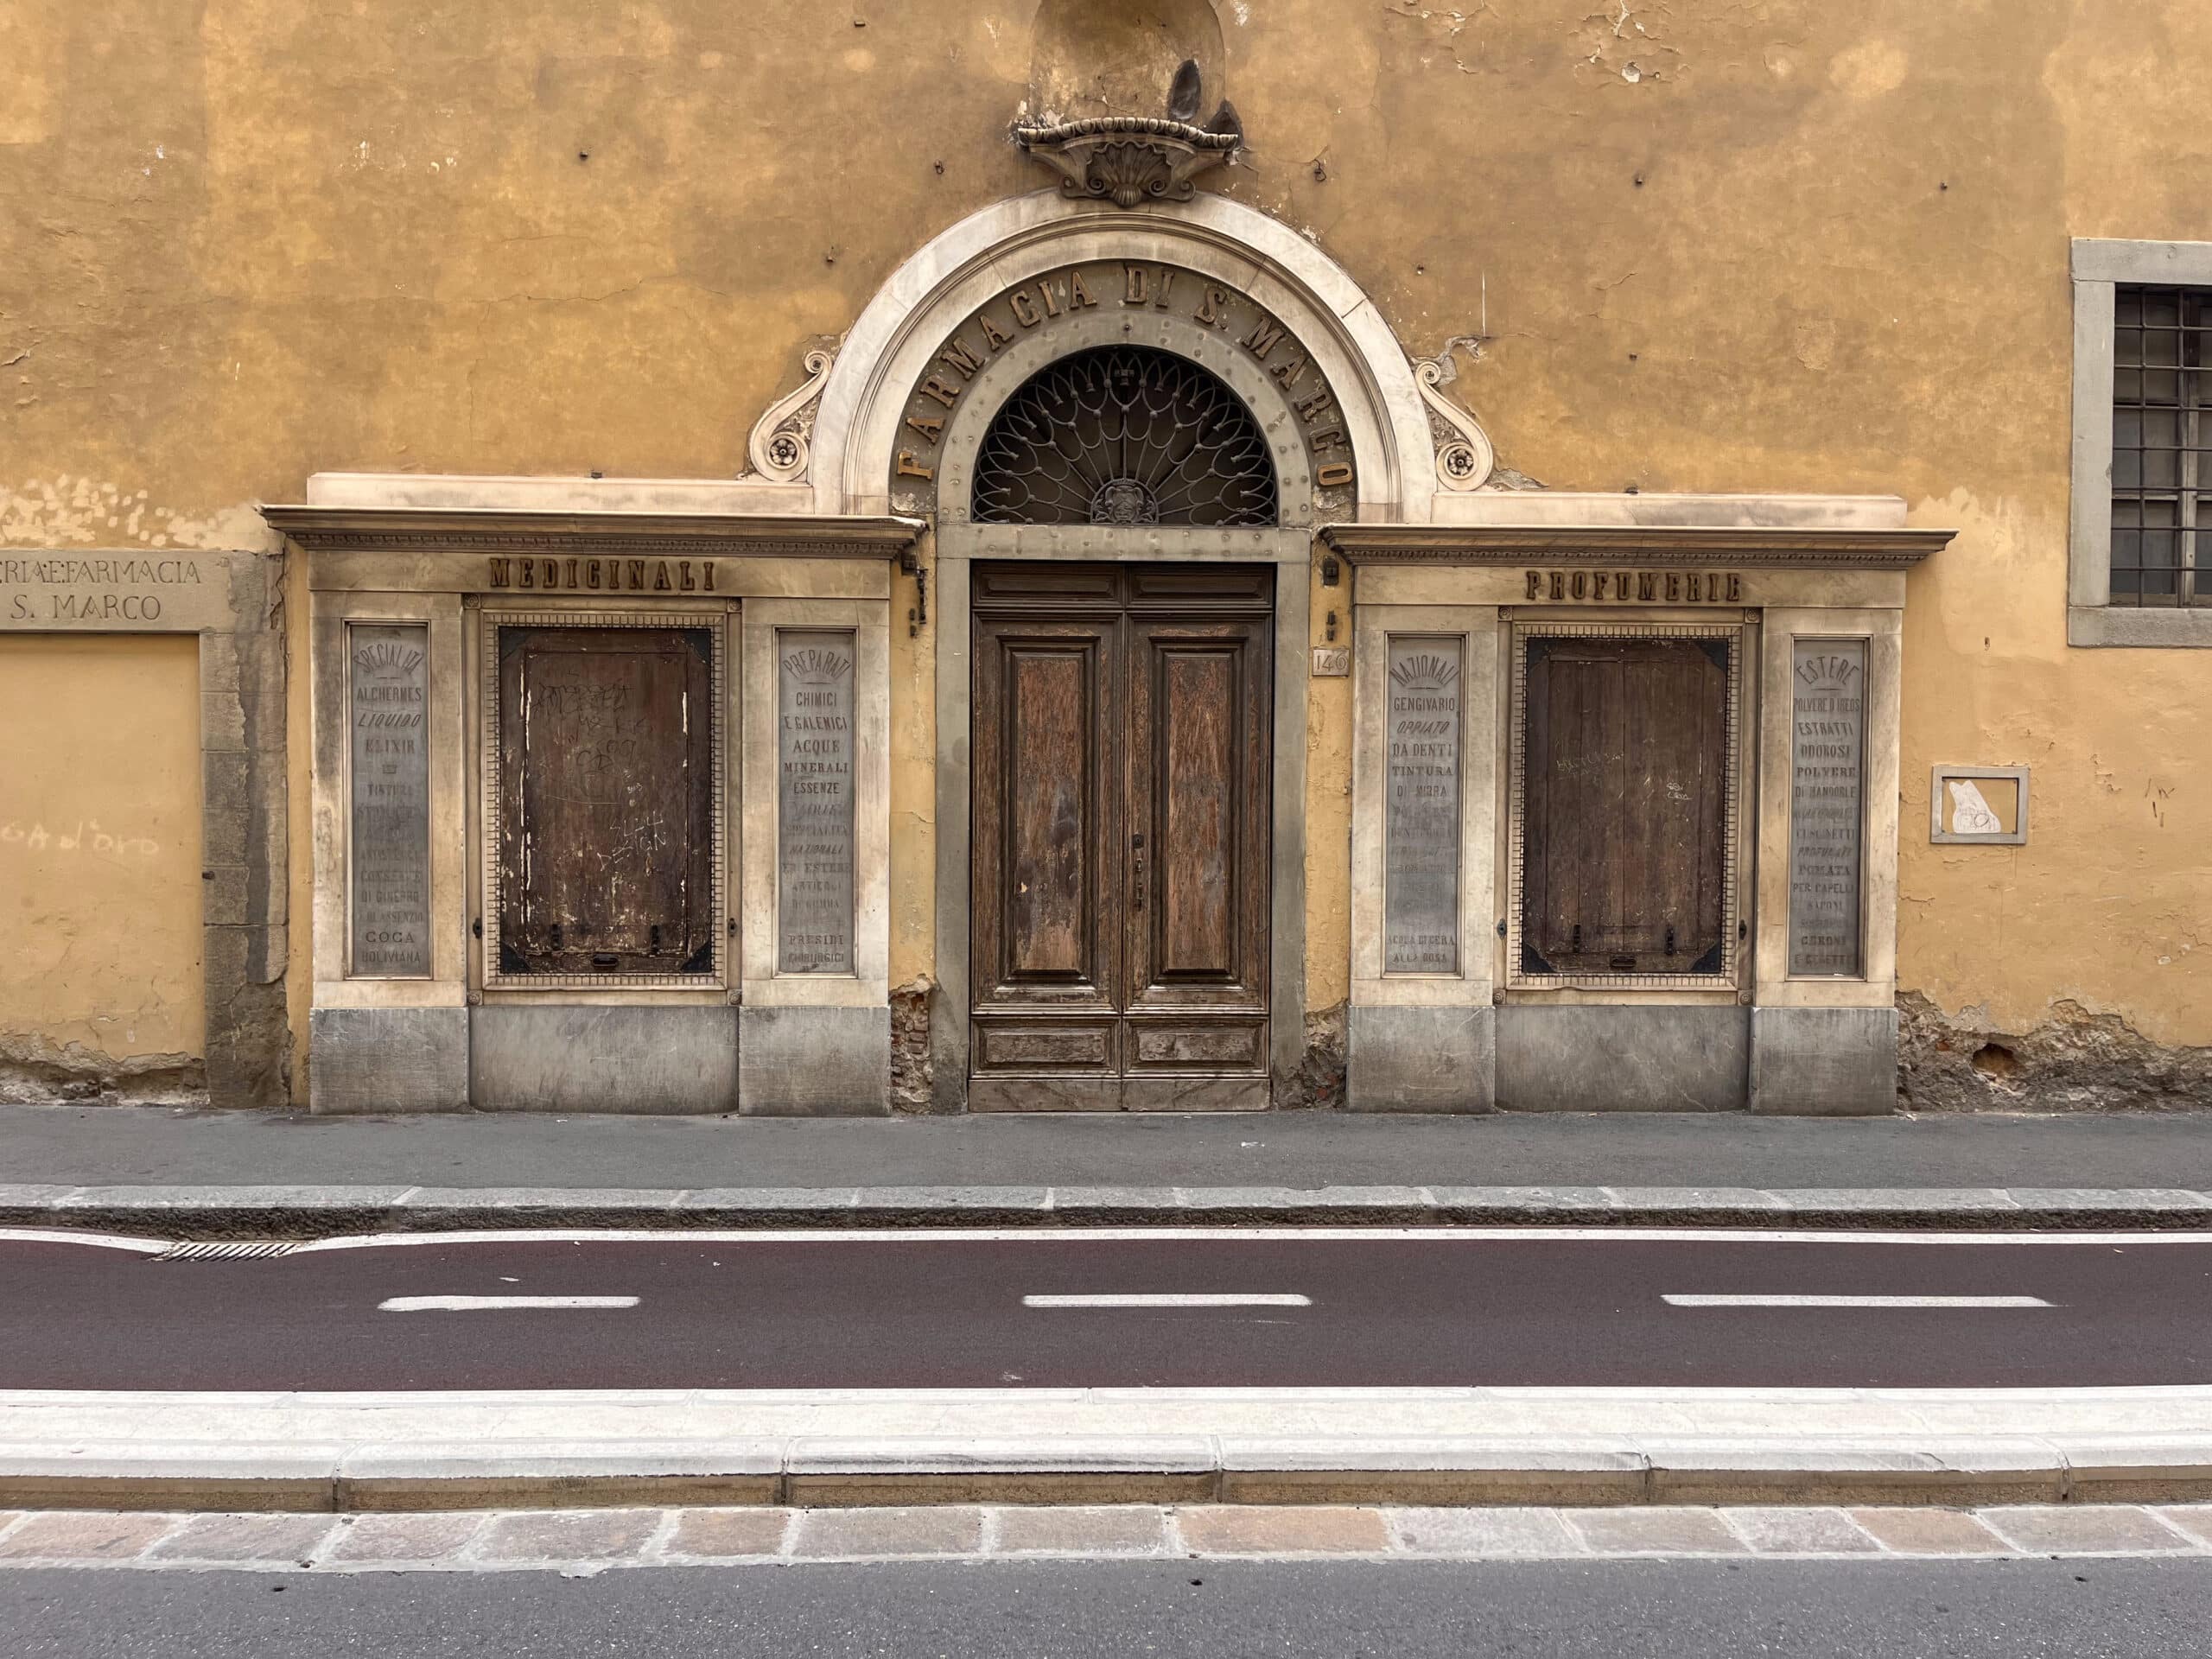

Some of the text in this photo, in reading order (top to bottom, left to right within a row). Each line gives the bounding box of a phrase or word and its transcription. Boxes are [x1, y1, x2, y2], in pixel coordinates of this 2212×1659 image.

[895, 270, 1098, 480] FARMACIA
[1123, 264, 1176, 308] DI
[1241, 315, 1355, 487] MARCO
[488, 557, 715, 591] MEDICINALI
[1525, 570, 1742, 602] PROFUMERIE
[10, 594, 162, 620] S. MARCO
[782, 649, 852, 680] PREPARATI
[1317, 651, 1348, 672] 146
[1389, 654, 1460, 688] NAZIONALI
[1796, 655, 1859, 685] ESTERE
[356, 686, 423, 702] ALCHERMES
[795, 691, 837, 707] CHIMICI
[1394, 696, 1455, 712] GENGIVARIO
[1793, 697, 1827, 712] POLVERE
[358, 713, 423, 728] LIQUIDO
[784, 715, 849, 731] E GALENICI
[1797, 721, 1854, 736] ESTRATTI
[792, 739, 841, 755] ACQUE
[1392, 742, 1452, 757] DA DENTI
[1800, 744, 1851, 759] ODOROSI
[783, 761, 849, 774] MINERALI
[1391, 766, 1453, 776] TINTURA
[1796, 766, 1857, 778] POLVERE
[793, 781, 841, 795] ESSENZE
[1795, 785, 1804, 798] DI
[789, 843, 844, 855] NAZIONALI
[365, 931, 416, 944] COCA
[361, 950, 422, 963] BOLIVIANA
